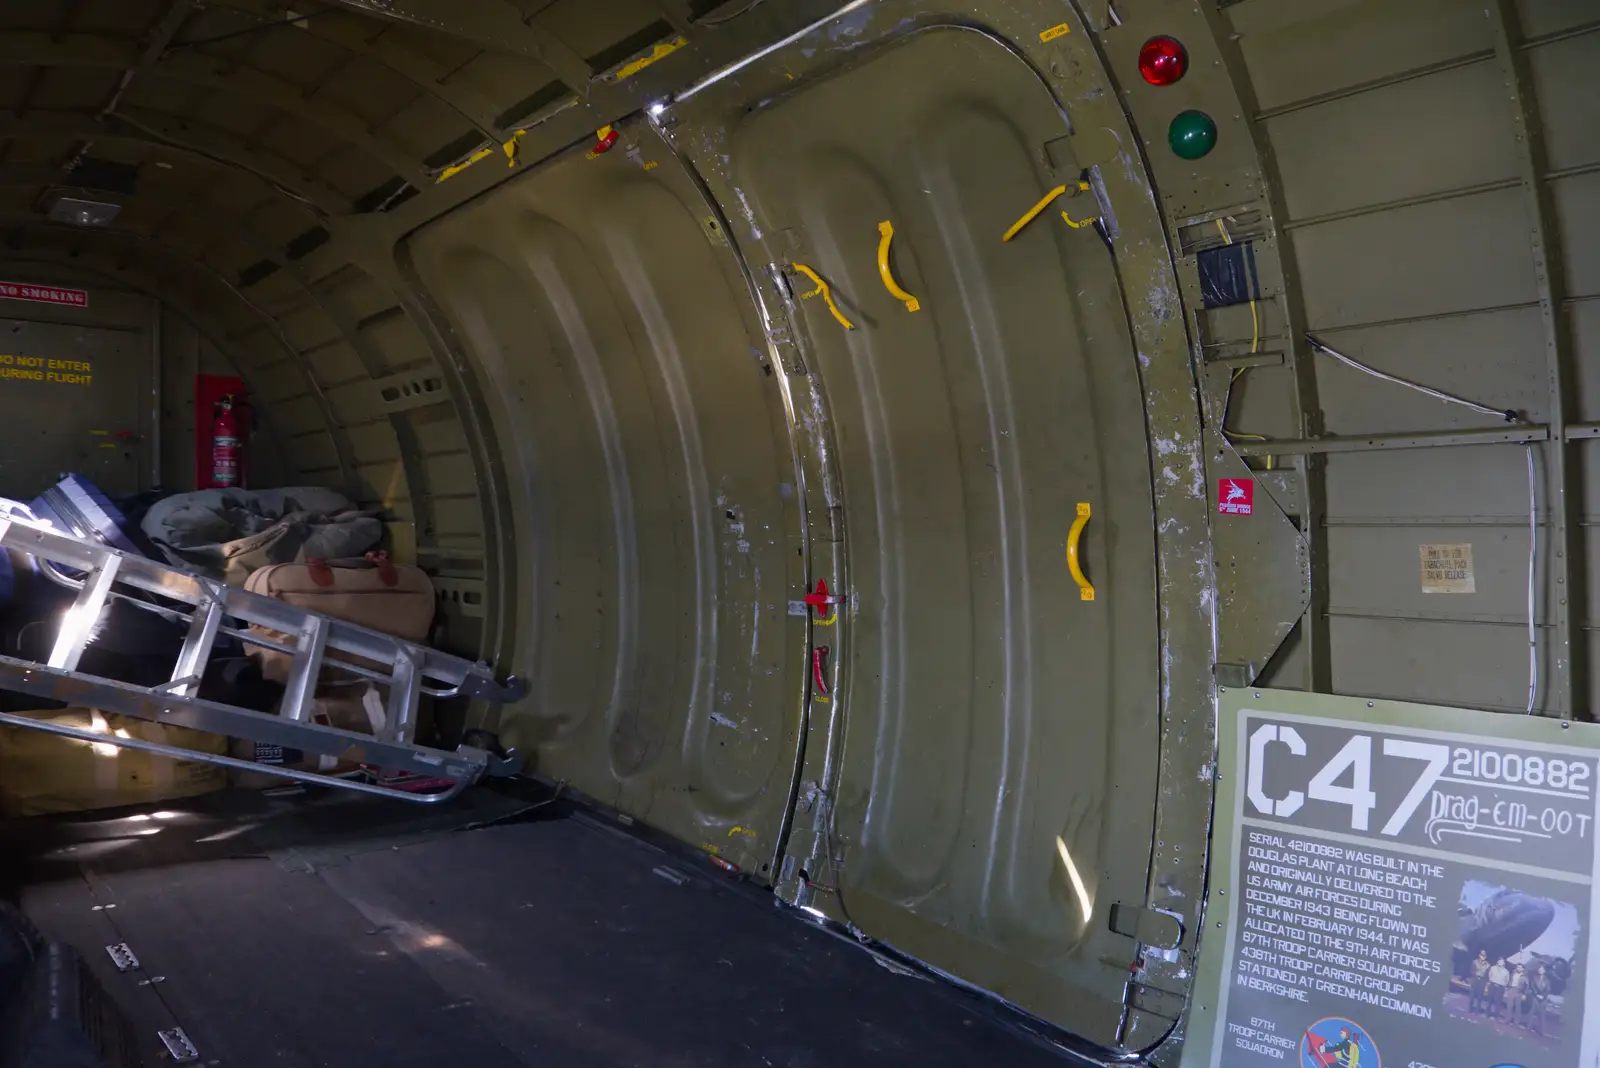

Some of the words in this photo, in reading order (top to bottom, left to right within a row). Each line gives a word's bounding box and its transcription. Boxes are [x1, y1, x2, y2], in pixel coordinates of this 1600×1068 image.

[0, 285, 17, 295] NO
[21, 287, 84, 303] SMOKING
[0, 367, 43, 381] URING
[46, 371, 93, 385] FLIGHT
[17, 355, 45, 368] NOT
[47, 358, 92, 372] ENTER
[1247, 724, 1449, 836] C47
[1452, 747, 1590, 792] 2100882
[1248, 846, 1297, 865] DOUGLAS
[1298, 855, 1335, 872] PLANT
[1336, 863, 1353, 875] AT
[1354, 866, 1384, 882] LONG
[1386, 872, 1427, 891] BEACH
[1249, 832, 1285, 848] SERIAL
[1287, 840, 1343, 859] 42100882
[1345, 849, 1372, 865] WAS
[1373, 854, 1406, 870] BUILT
[1407, 861, 1418, 873] IN
[1420, 863, 1444, 878] THE
[1246, 874, 1261, 887] US
[1263, 878, 1293, 893] ARMY
[1295, 885, 1314, 897] AIR
[1315, 888, 1358, 907] FORCES
[1360, 897, 1402, 916] DURING
[1247, 861, 1269, 874] AND
[1271, 865, 1332, 886] ORIGINALLY
[1334, 877, 1394, 899] DELIVERED
[1395, 890, 1411, 903] TO
[1413, 893, 1436, 908] THE
[1246, 888, 1302, 910] DECEMBER
[1304, 901, 1331, 916] 1943
[1333, 908, 1367, 925] BEING
[1369, 915, 1409, 934] FLOWN
[1411, 924, 1427, 938] TO
[1246, 902, 1265, 916] THE
[1266, 908, 1280, 920] UK
[1283, 911, 1293, 923] IN
[1294, 914, 1354, 937] FEBRUARY
[1356, 928, 1386, 944] 1944.
[1388, 935, 1399, 947] IT
[1401, 938, 1430, 954] WAS
[1243, 931, 1271, 948] 87TH
[1272, 938, 1307, 955] TROOP
[1307, 947, 1356, 968] CARRIER
[1357, 958, 1421, 985] SQUADRON
[1422, 975, 1430, 986] /
[1244, 917, 1305, 941] ALLOCATED
[1307, 931, 1322, 944] TO
[1323, 934, 1344, 950] THE
[1345, 941, 1369, 956] 9TH
[1370, 947, 1390, 961] AIR
[1391, 951, 1441, 973] FORCES
[1237, 973, 1247, 986] IN
[1248, 976, 1309, 1003] BERKSHIRE.
[1239, 959, 1297, 984] STATIONED
[1298, 975, 1314, 988] AT
[1315, 979, 1379, 1005] GREENHAM
[1380, 996, 1432, 1020] COMMON
[1241, 946, 1277, 964] 438TH
[1278, 954, 1313, 972] TROOP
[1314, 963, 1362, 985] CARRIER
[1364, 976, 1404, 995] GROUP
[1228, 1022, 1257, 1038] TROOP
[1256, 1031, 1296, 1050] CARRIER
[1250, 1016, 1275, 1032] 87TH
[1235, 1037, 1284, 1060] SQUADRON
